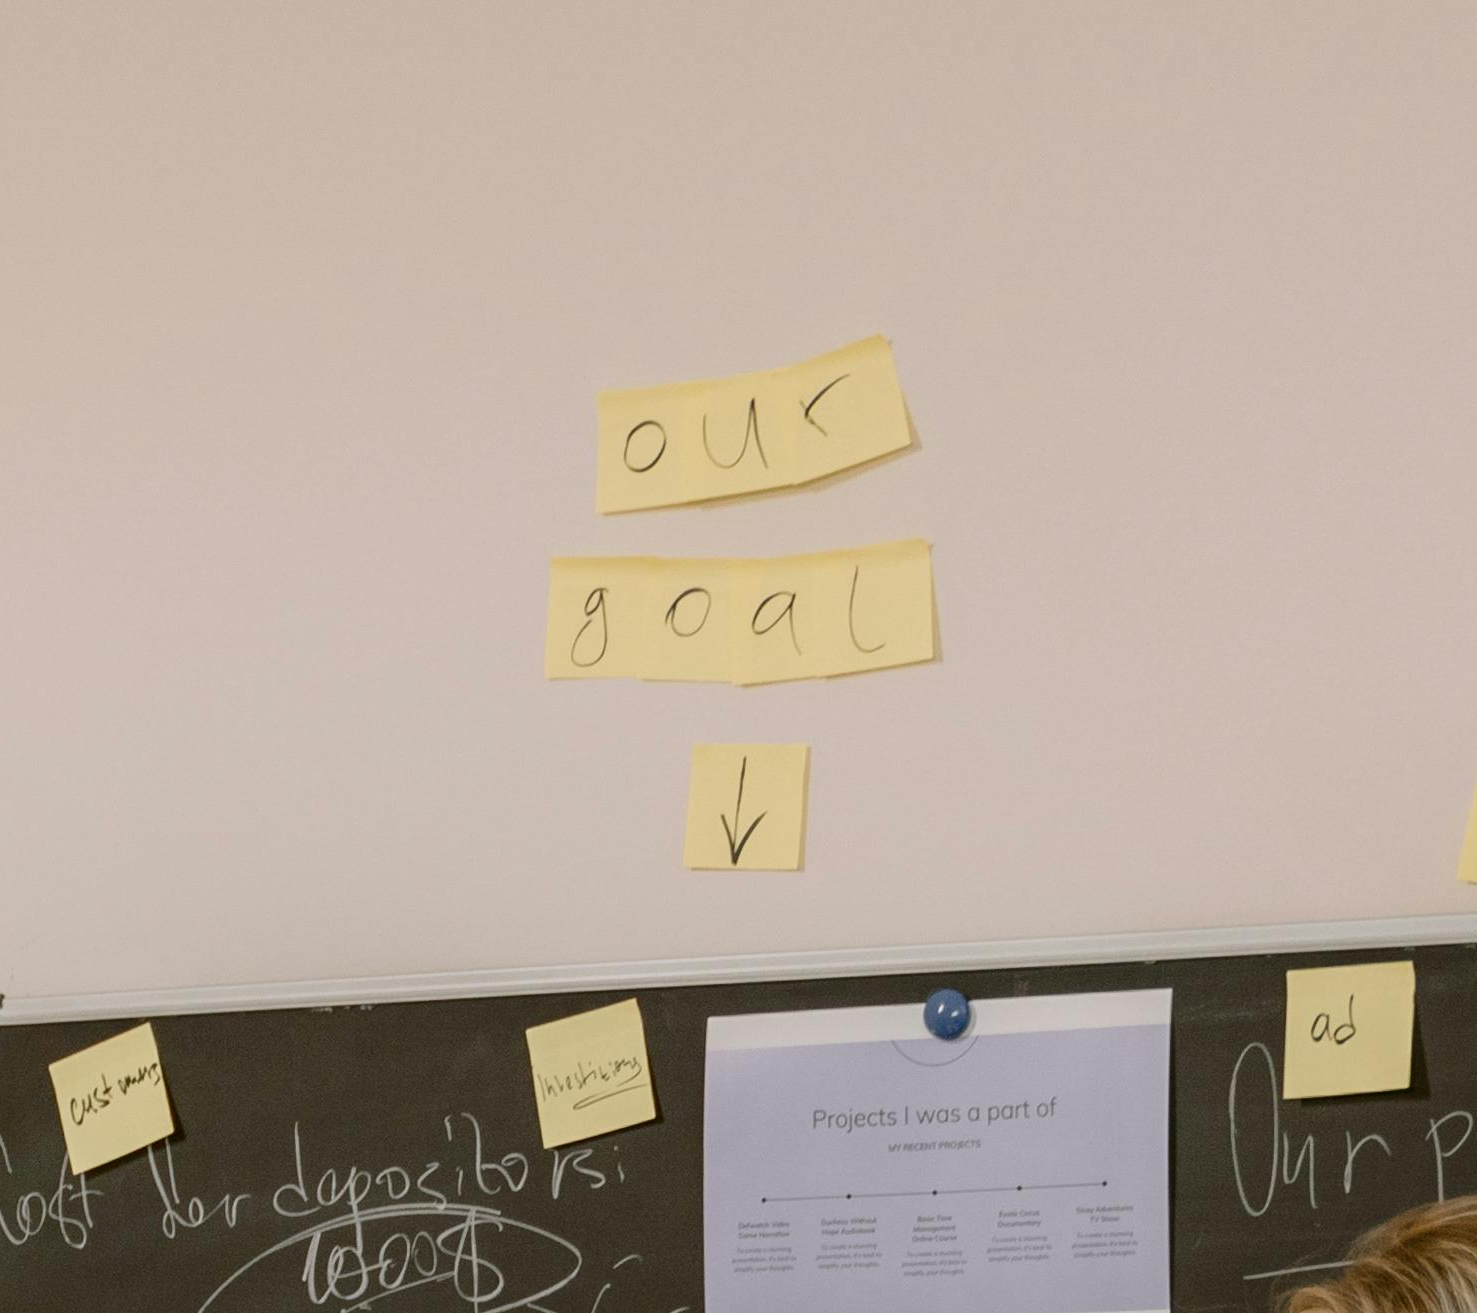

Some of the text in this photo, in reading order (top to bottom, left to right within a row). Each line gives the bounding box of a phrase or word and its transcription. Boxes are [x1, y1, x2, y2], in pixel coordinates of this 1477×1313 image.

[623, 373, 851, 473] our
[570, 565, 886, 667] goal
[1310, 993, 1357, 1045] ad
[812, 1096, 1058, 1134] Projects I was a part of
[1228, 1041, 1392, 1218] Our
